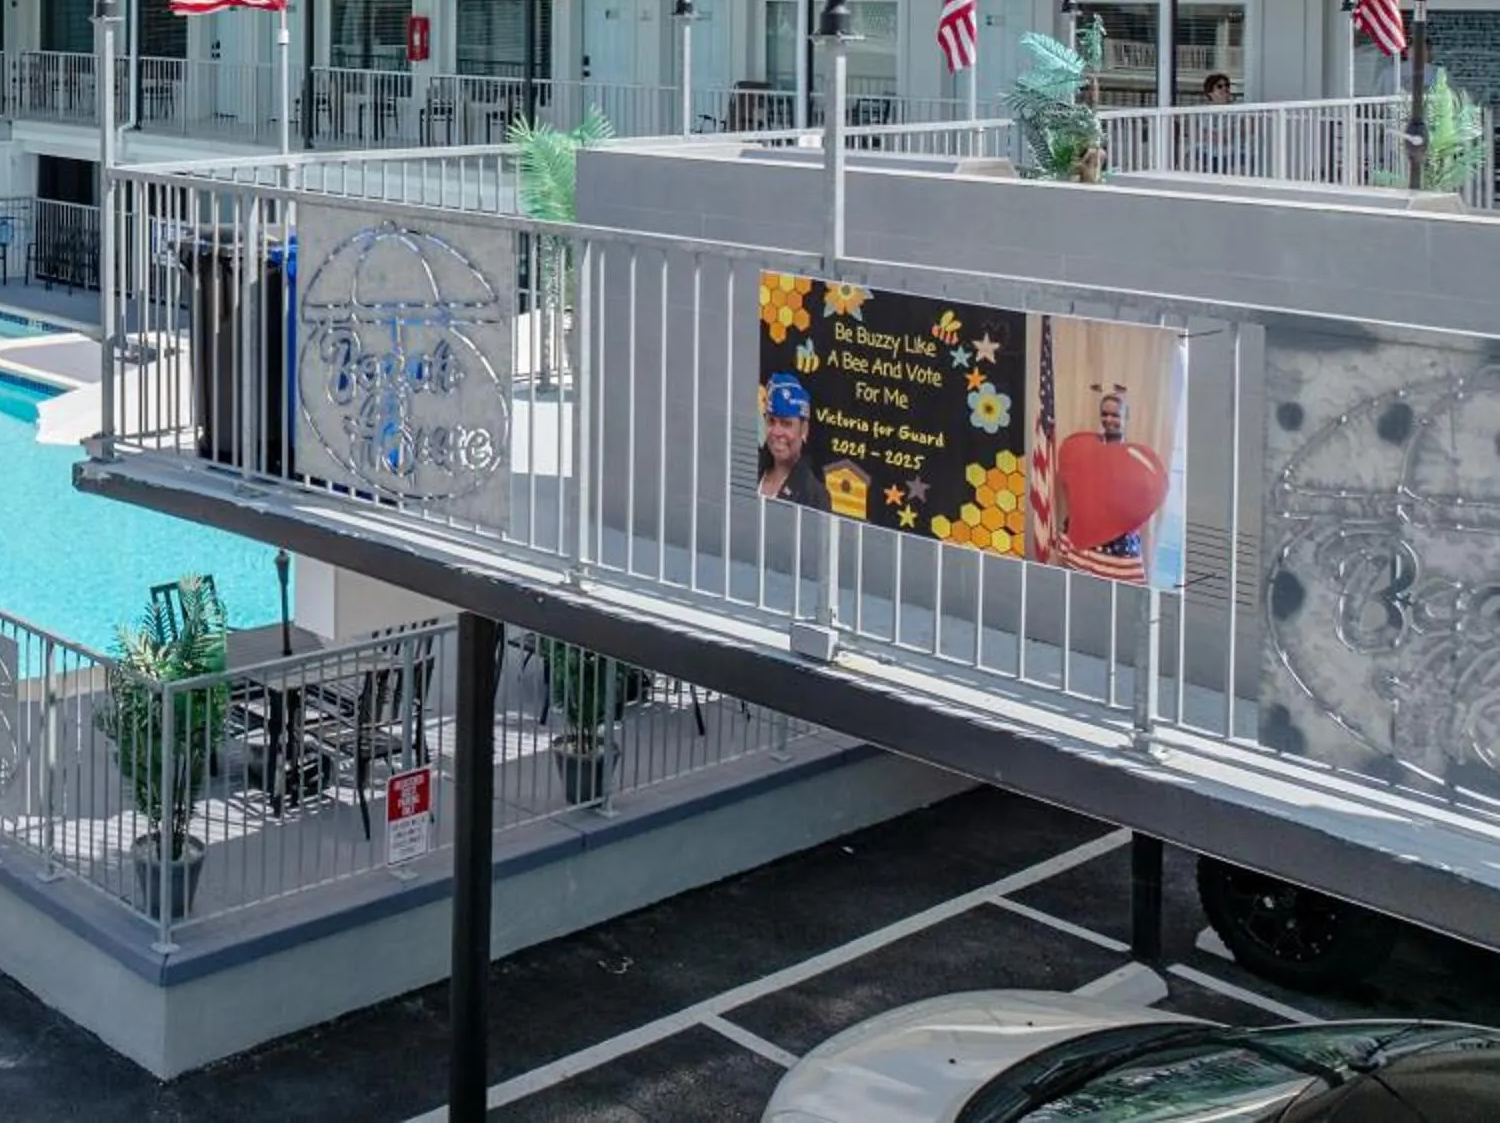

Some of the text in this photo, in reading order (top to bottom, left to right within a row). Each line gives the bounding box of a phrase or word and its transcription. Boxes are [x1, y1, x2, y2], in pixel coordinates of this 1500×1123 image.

[835, 322, 937, 359] Be Buzzy Like
[827, 349, 942, 387] A Bee And Vote
[855, 381, 908, 409] For Me
[816, 407, 945, 448] Victoria for Guard
[884, 449, 926, 470] 2025
